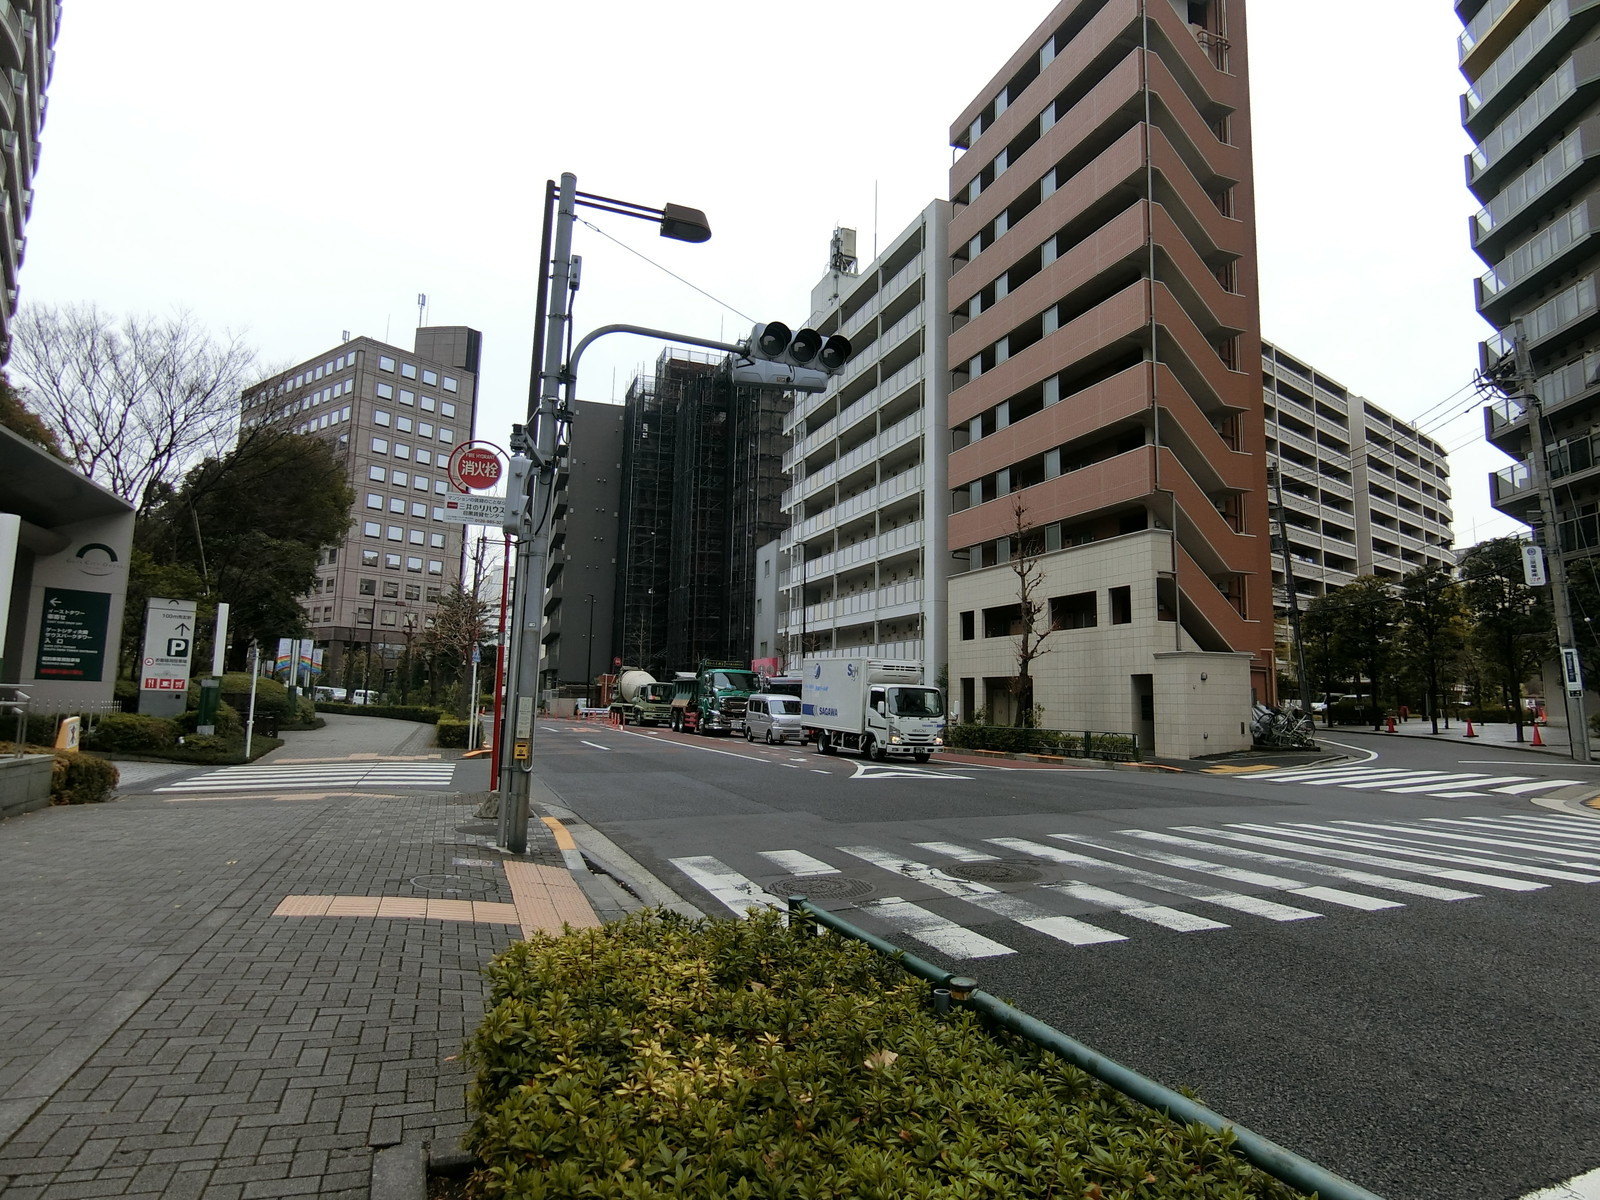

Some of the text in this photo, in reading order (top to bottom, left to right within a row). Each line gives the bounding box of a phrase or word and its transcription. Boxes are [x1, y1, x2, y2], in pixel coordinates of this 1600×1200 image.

[461, 460, 499, 478] 消火栓
[460, 502, 505, 514] 三井のリハウス
[48, 608, 86, 616] イーストタワー
[170, 639, 186, 656] P
[819, 706, 838, 717] SAGAWA
